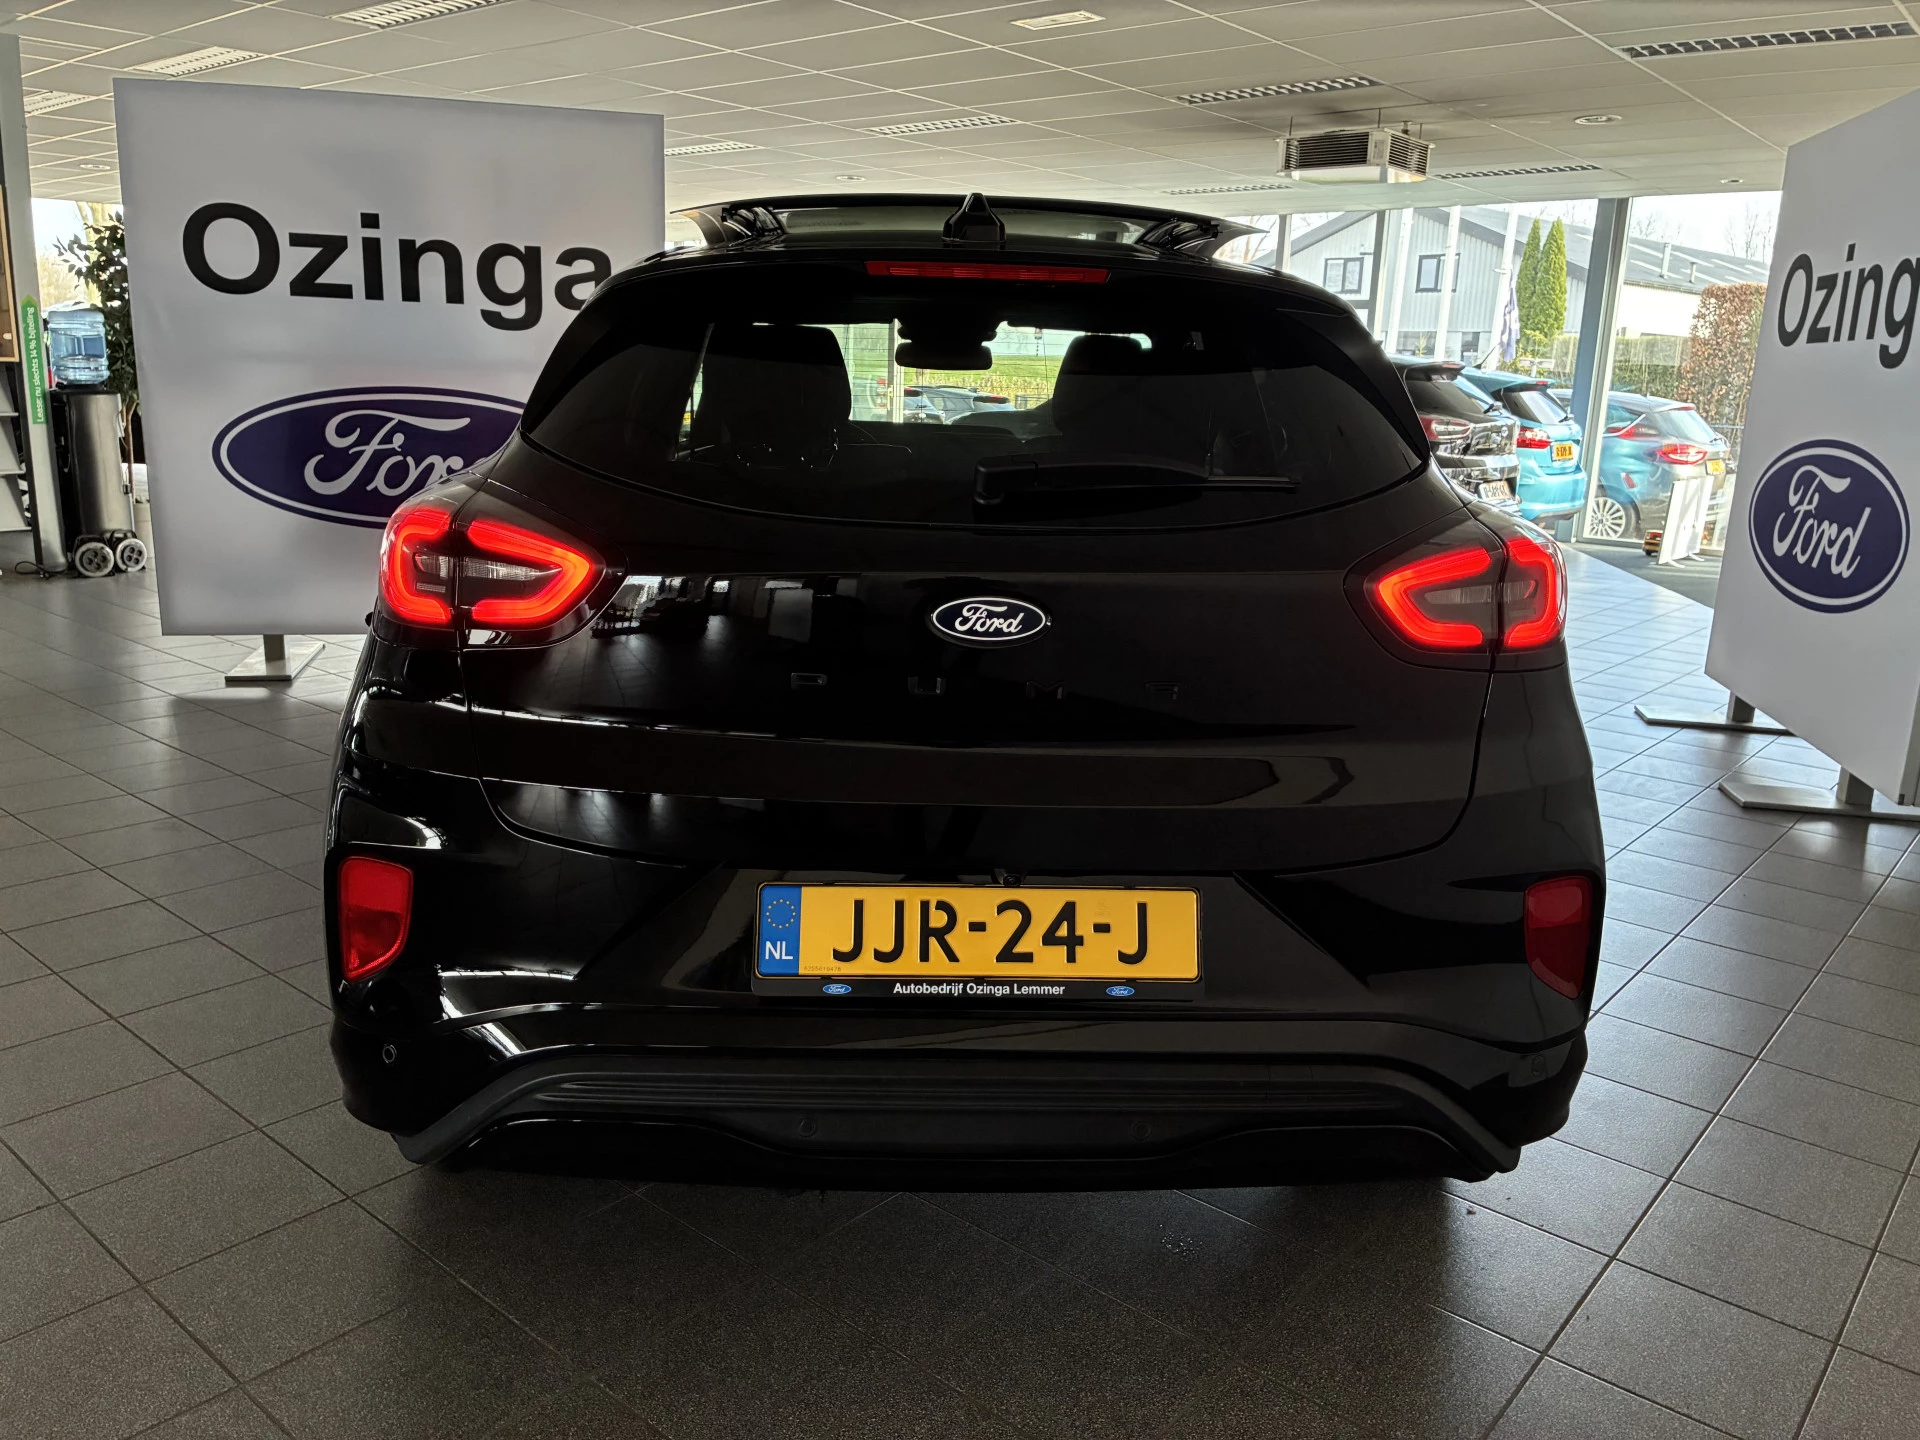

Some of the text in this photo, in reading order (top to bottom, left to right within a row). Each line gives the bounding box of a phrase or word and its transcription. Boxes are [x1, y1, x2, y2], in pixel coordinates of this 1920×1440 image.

[182, 202, 612, 331] Ozinga
[1777, 243, 1920, 369] Ozing
[27, 306, 36, 338] bijtelling
[32, 358, 41, 385] slechts
[35, 386, 41, 396] nu
[304, 409, 486, 497] For
[1773, 465, 1871, 578] Ford
[955, 603, 1023, 634] Ford
[832, 899, 1148, 965] JJR-24-J
[765, 940, 794, 961] NL
[828, 985, 845, 993] Ford
[893, 982, 1066, 996] Autobedrijf Ozinga Lemmer
